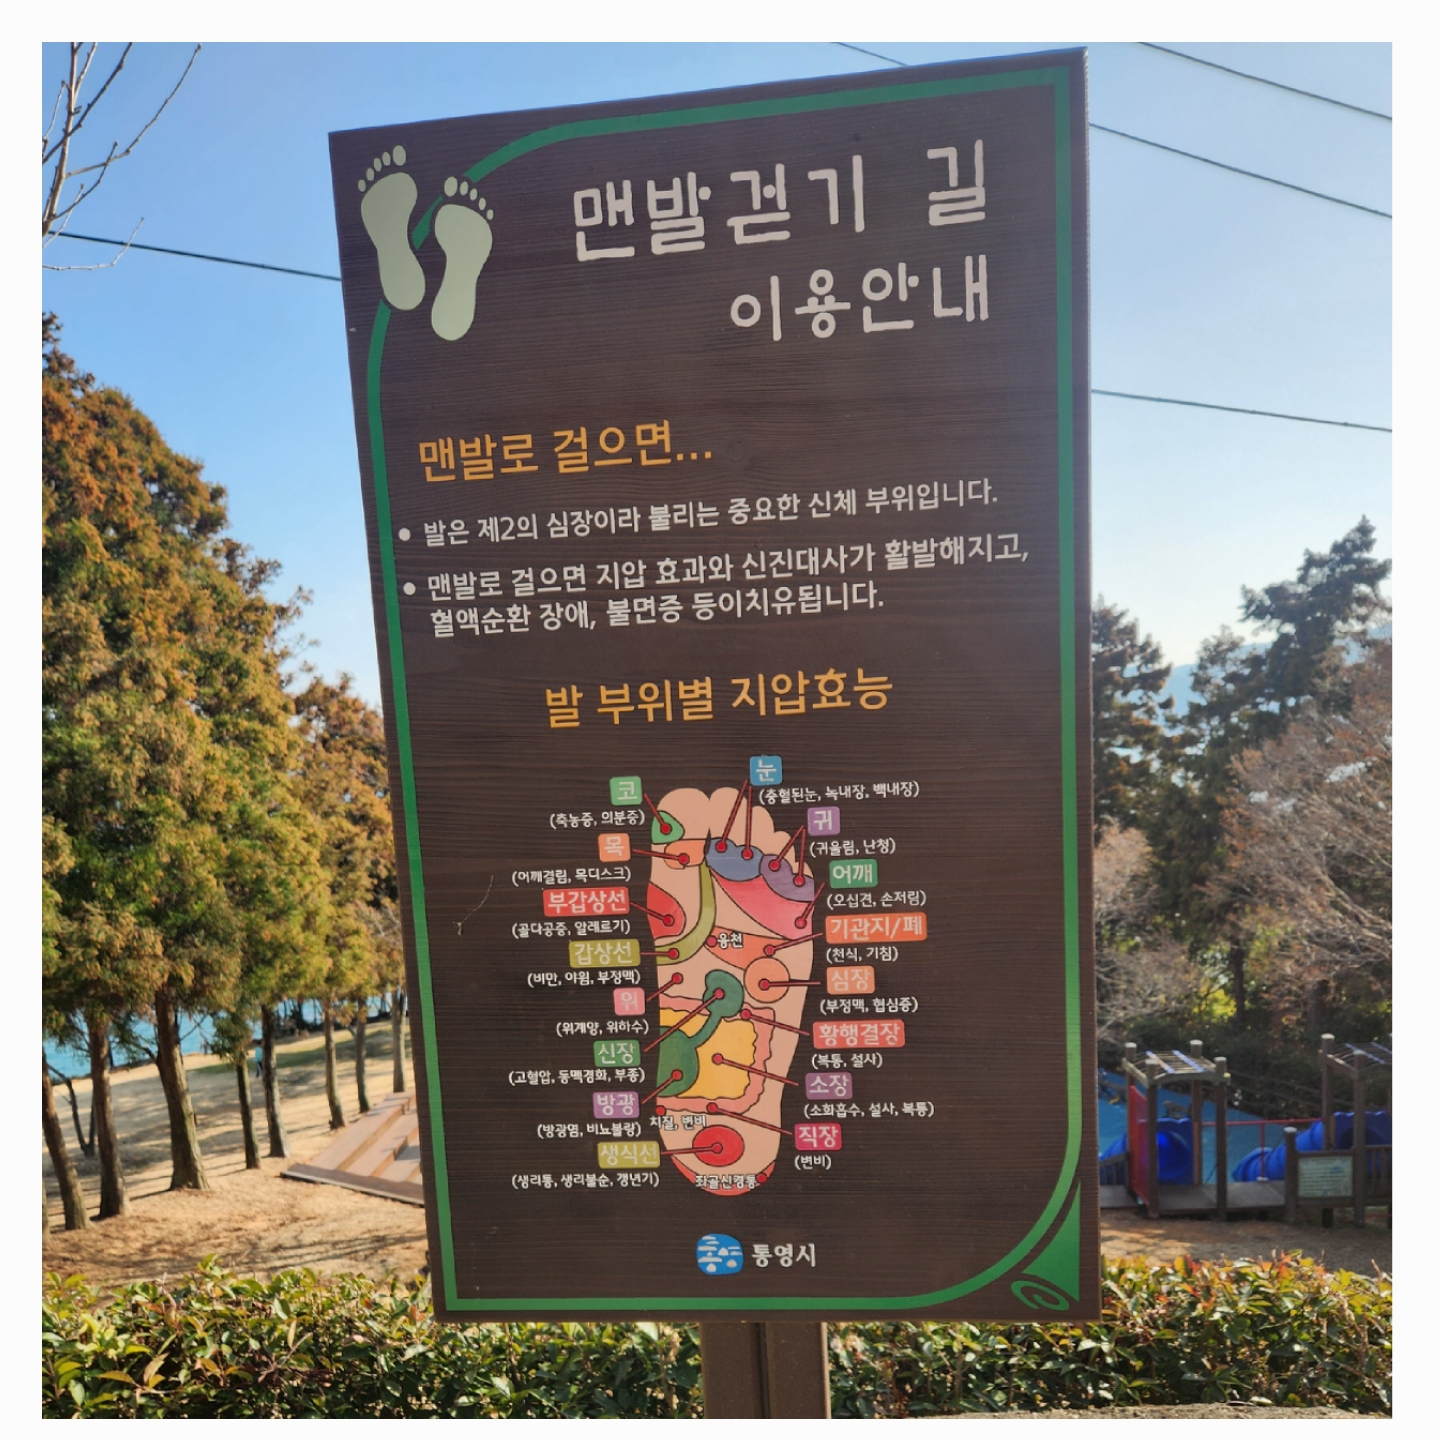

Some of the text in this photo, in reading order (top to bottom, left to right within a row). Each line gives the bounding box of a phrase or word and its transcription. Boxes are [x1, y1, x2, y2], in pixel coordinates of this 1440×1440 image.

[573, 139, 986, 261] 맨발걷기 길
[730, 254, 989, 341] 이용안내
[419, 433, 539, 482] 맨발로
[424, 478, 998, 547] 발은 제2의 심장이라 불리는 중요한 신체 부위입니다.
[428, 533, 1028, 602] 맨발로 걸으면 지압 효과와 신진대사가 활발해지고,
[430, 580, 884, 638] 혈액순환 장애, 불면증 등이치유됩니다.
[545, 667, 893, 728] 발 부위별 지압효능
[756, 759, 777, 782] 눈
[617, 781, 638, 800] 코
[758, 780, 920, 805] (충혈된눈, 녹내장, 백내장)
[550, 812, 598, 830] (축농증,
[813, 810, 833, 831] 귀
[604, 836, 624, 858] 목
[809, 837, 896, 858] (귀울림, 난청)
[575, 866, 631, 882] 목디스크)
[832, 863, 873, 885] 어깨
[548, 889, 627, 914] 부갑상선
[826, 889, 927, 910] (오십견, 손저림)
[512, 918, 631, 939] (골다공증, 알레르기)
[830, 915, 923, 941] 기관지/폐
[574, 941, 632, 966] 갑상선
[826, 946, 899, 964] (천식, 기침)
[527, 972, 562, 988] (비만,
[597, 969, 641, 985] 부정맥)
[831, 968, 871, 992] 심장
[620, 991, 638, 1011] 위
[820, 996, 919, 1015] (부정맥, 협심증)
[606, 1019, 649, 1035] 위하수)
[598, 1042, 636, 1065] 신장
[811, 1052, 883, 1069] (복통, 설사)
[509, 1067, 645, 1086] (고혈압, 동맥경화, 부종)
[809, 1074, 849, 1096] 소장
[597, 1093, 635, 1116] 방광
[804, 1101, 935, 1119] (소화흡수, 설사, 복통)
[537, 1122, 642, 1139] (방광염, 비뇨불량)
[681, 1115, 707, 1130] 변비
[798, 1126, 839, 1148] 직장
[600, 1143, 658, 1166] 생식선
[794, 1155, 832, 1171] (변비)
[512, 1172, 660, 1189] (생리통, 생리불순, 갱년기)
[752, 1243, 817, 1268] 통영시
